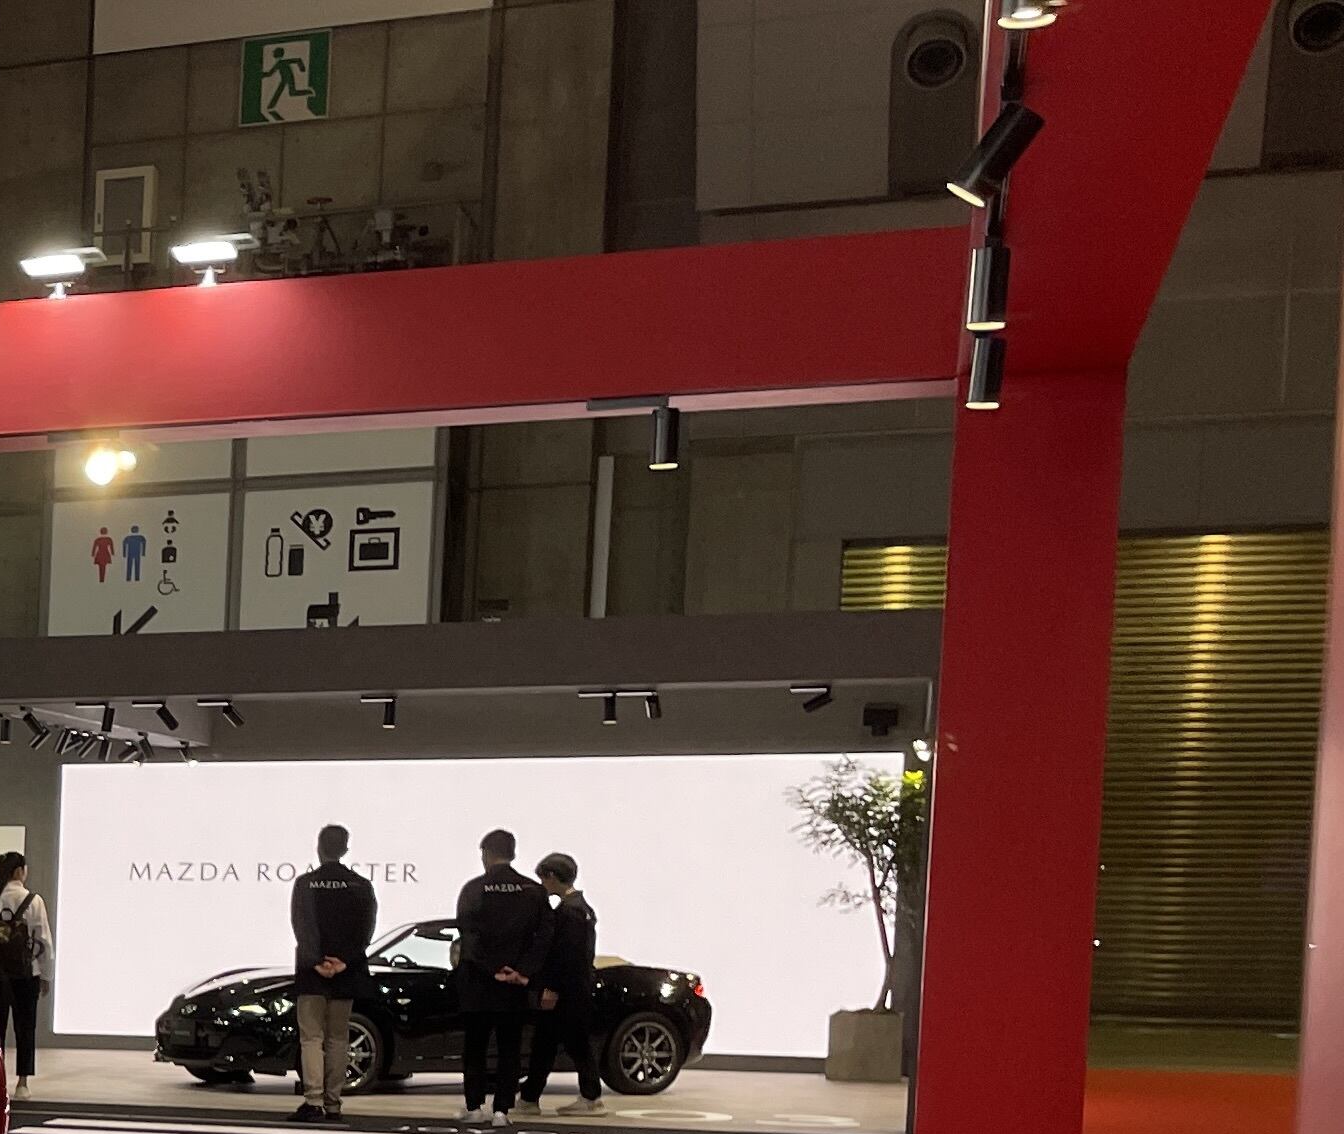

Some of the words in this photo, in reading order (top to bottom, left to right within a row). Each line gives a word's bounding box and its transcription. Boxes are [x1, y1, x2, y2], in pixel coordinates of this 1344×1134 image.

[129, 862, 241, 882] MAZDA
[257, 862, 419, 883] ROTER
[309, 880, 348, 889] MAZDA
[484, 883, 523, 893] MAZDA
